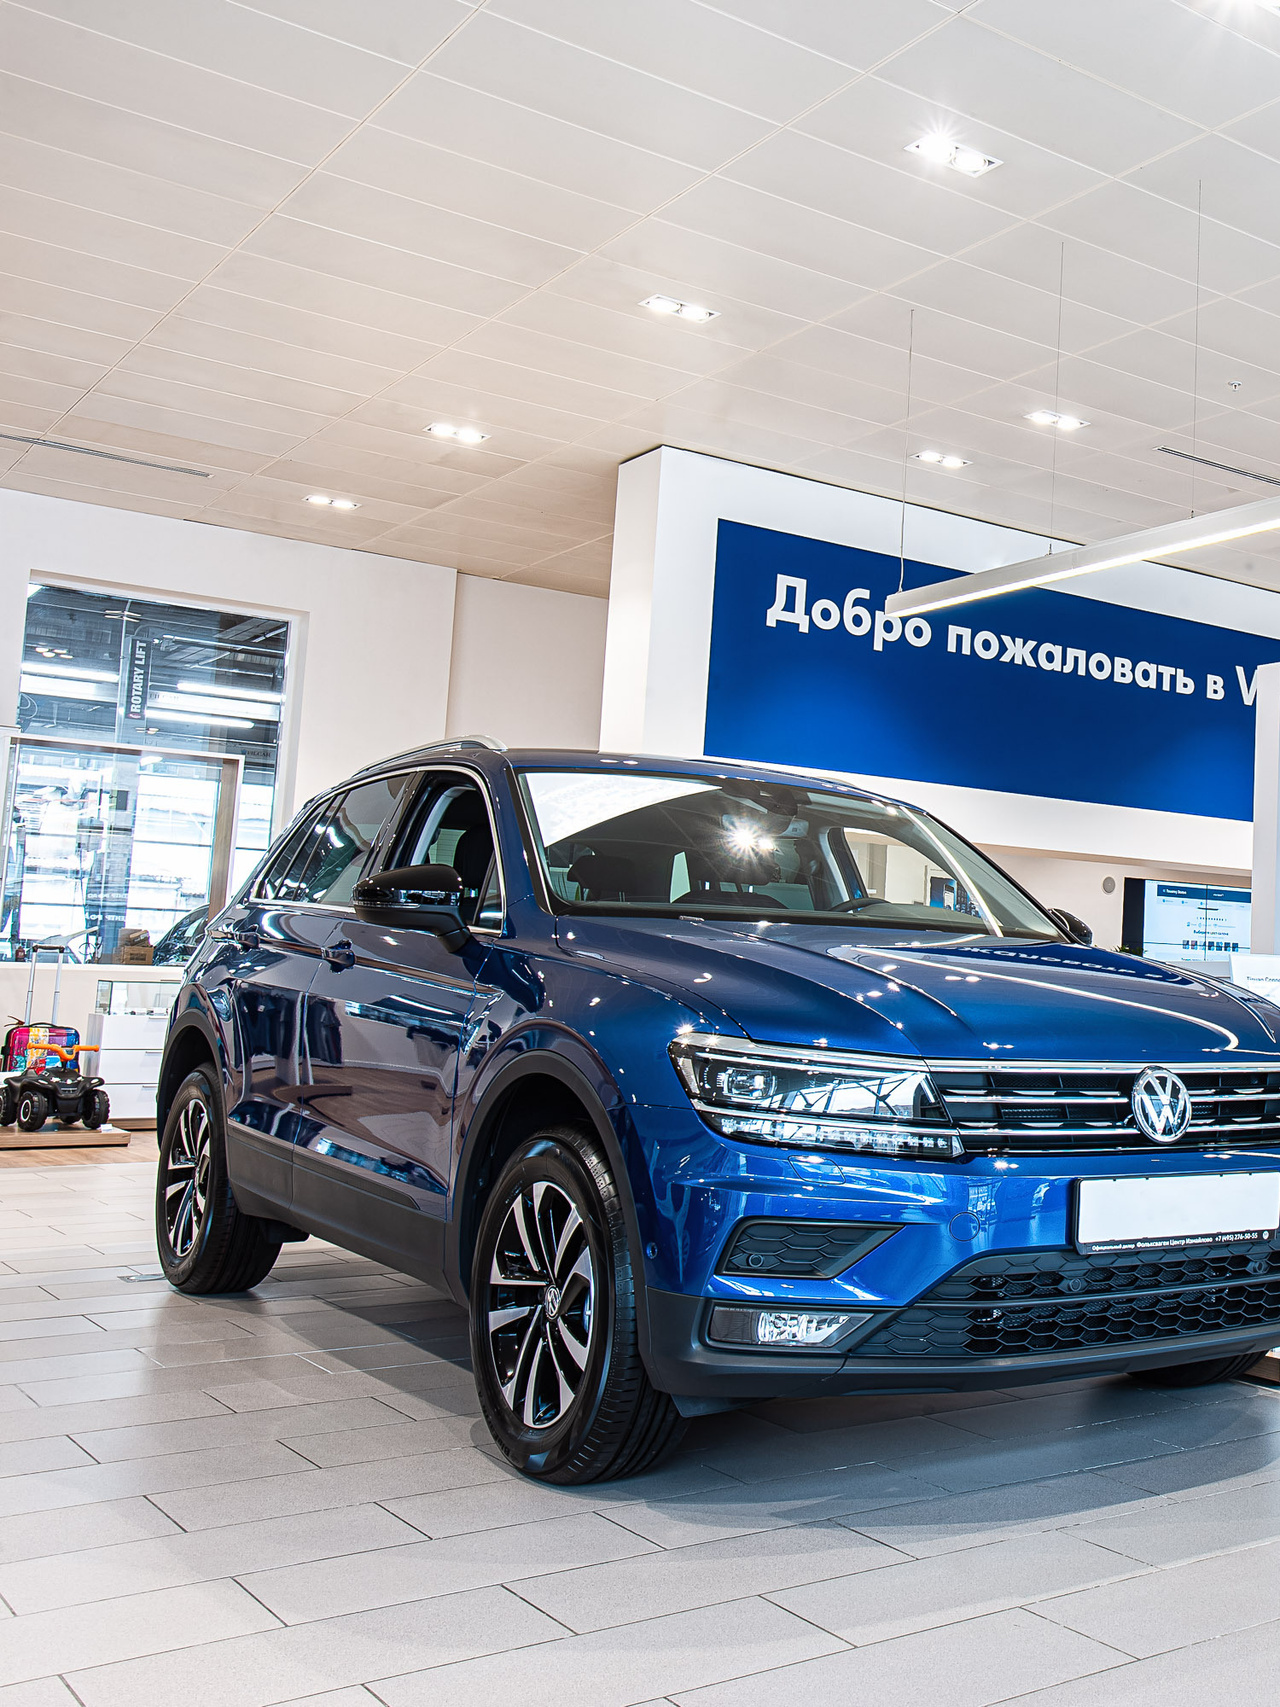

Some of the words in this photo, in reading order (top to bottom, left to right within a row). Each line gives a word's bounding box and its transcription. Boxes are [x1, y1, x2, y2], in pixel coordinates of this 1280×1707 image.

[134, 640, 147, 665] LIFT
[765, 573, 933, 652] Добро
[946, 624, 1196, 696] пожаловать
[1205, 673, 1226, 700] в
[130, 667, 144, 713] ROTARY
[1136, 1240, 1169, 1248] Фольксваген
[1186, 1236, 1213, 1244] Измайлово
